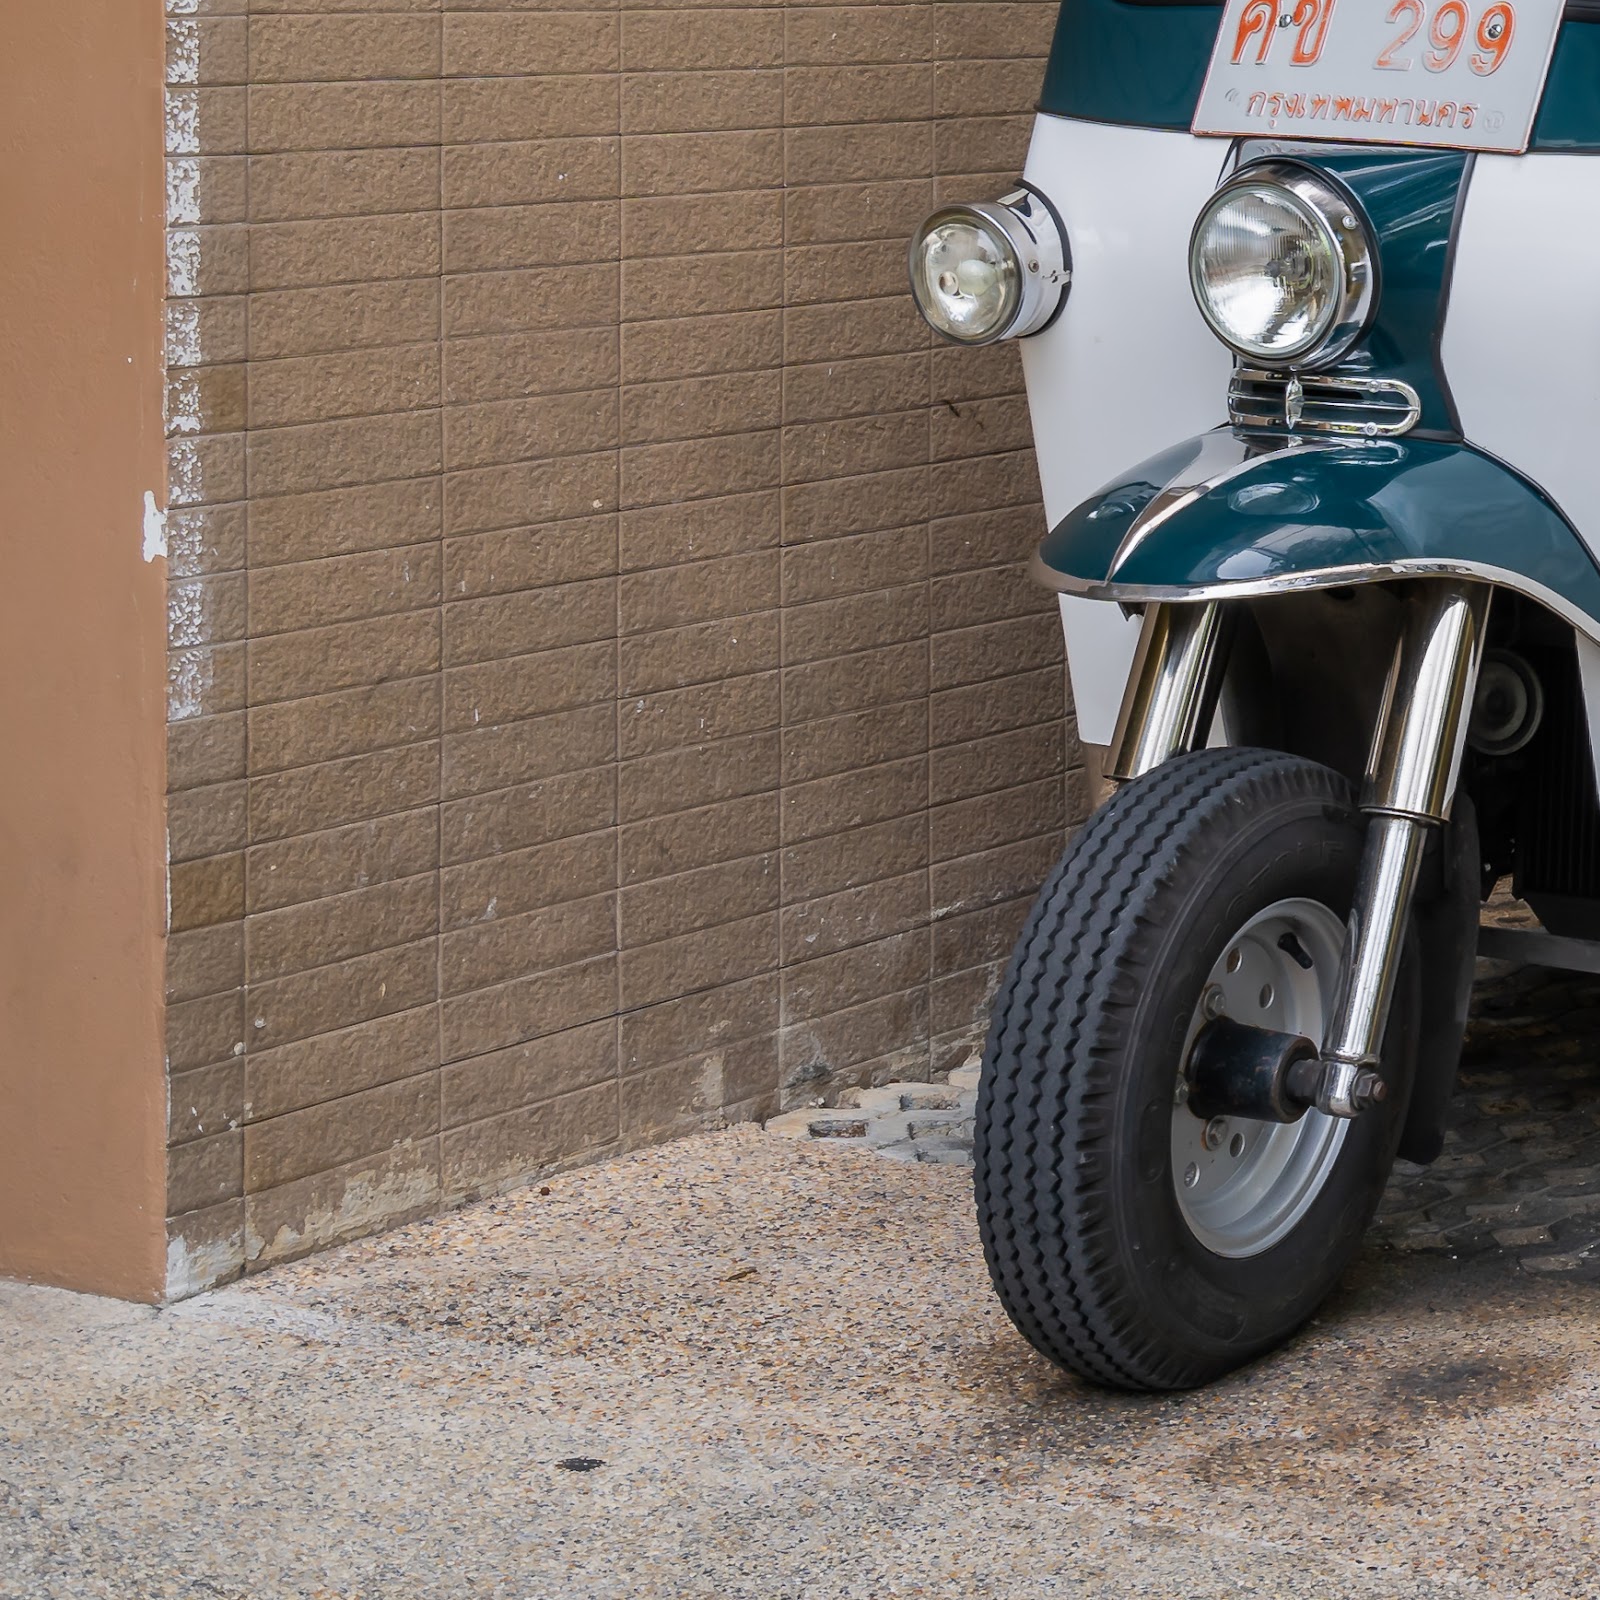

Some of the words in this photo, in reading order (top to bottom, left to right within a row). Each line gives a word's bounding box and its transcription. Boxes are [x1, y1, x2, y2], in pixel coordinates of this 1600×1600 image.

[1245, 89, 1480, 130] กรุงเทพมหานคร
